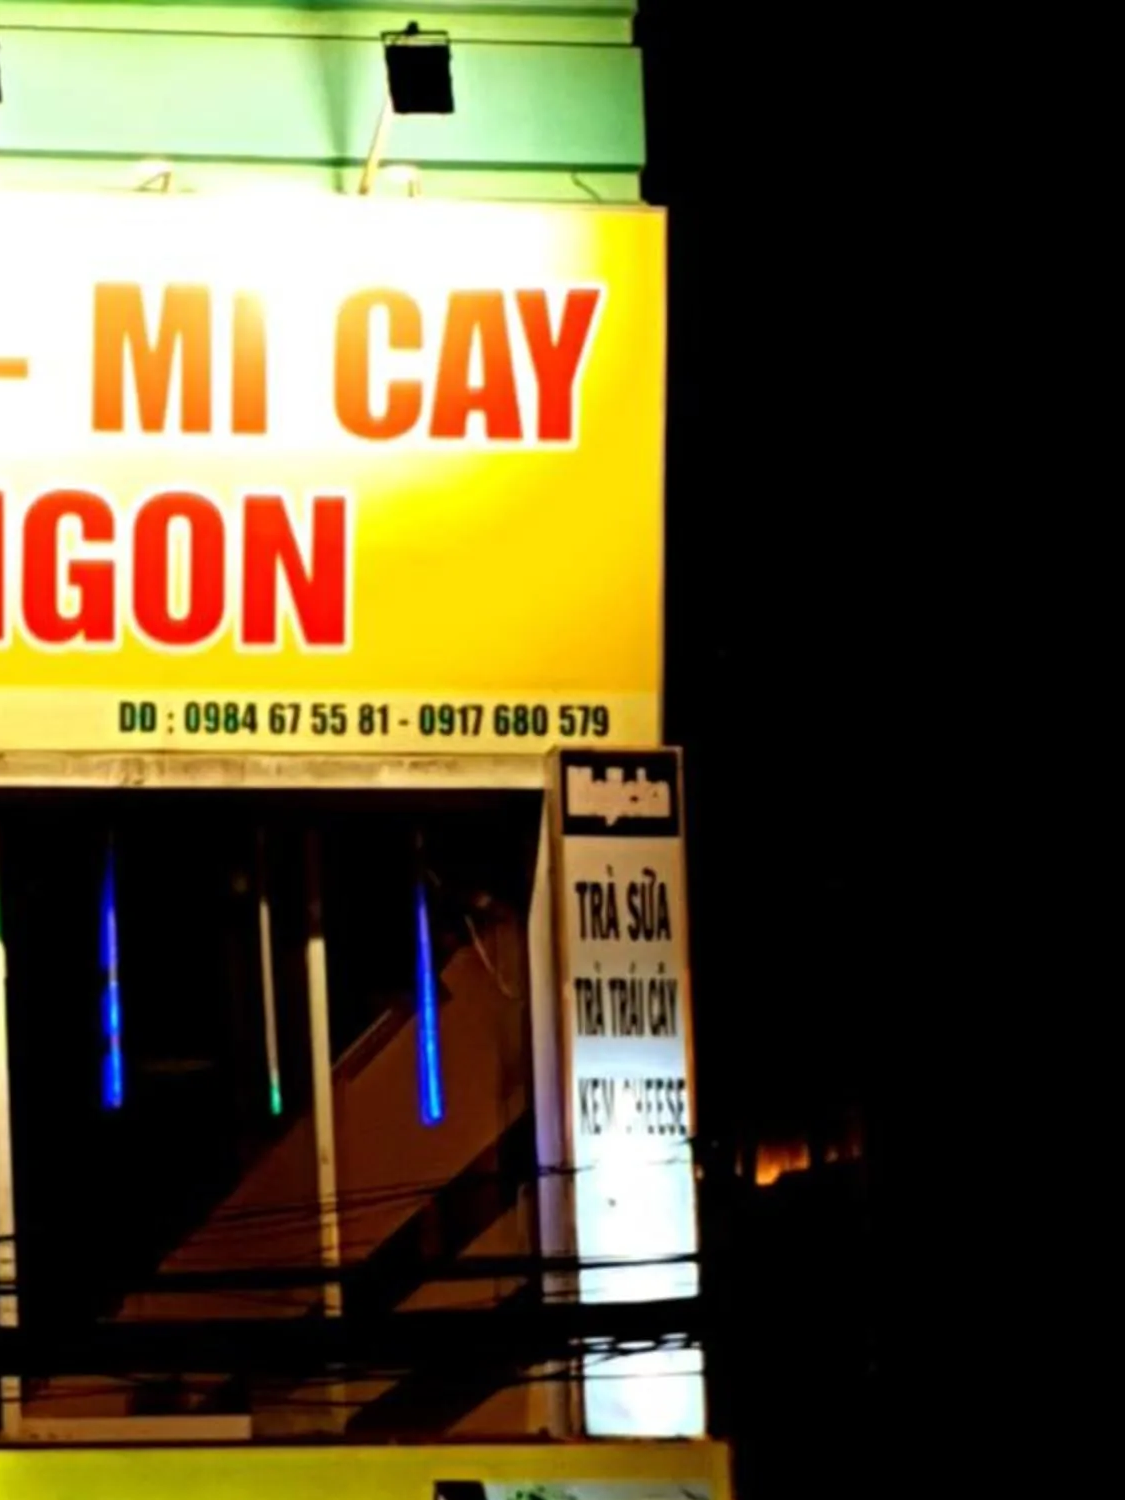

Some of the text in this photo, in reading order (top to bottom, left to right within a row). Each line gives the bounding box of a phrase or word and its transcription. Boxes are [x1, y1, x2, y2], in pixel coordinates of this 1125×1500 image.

[333, 287, 602, 442] CAY
[185, 701, 258, 734] 0984
[269, 702, 301, 735] 67
[310, 703, 348, 735] 55
[358, 703, 389, 736] 81
[419, 704, 483, 737] 0917
[492, 704, 549, 737] 680
[559, 705, 611, 738] 579
[574, 864, 620, 941] TRÀ
[574, 960, 605, 1037] TRÀ
